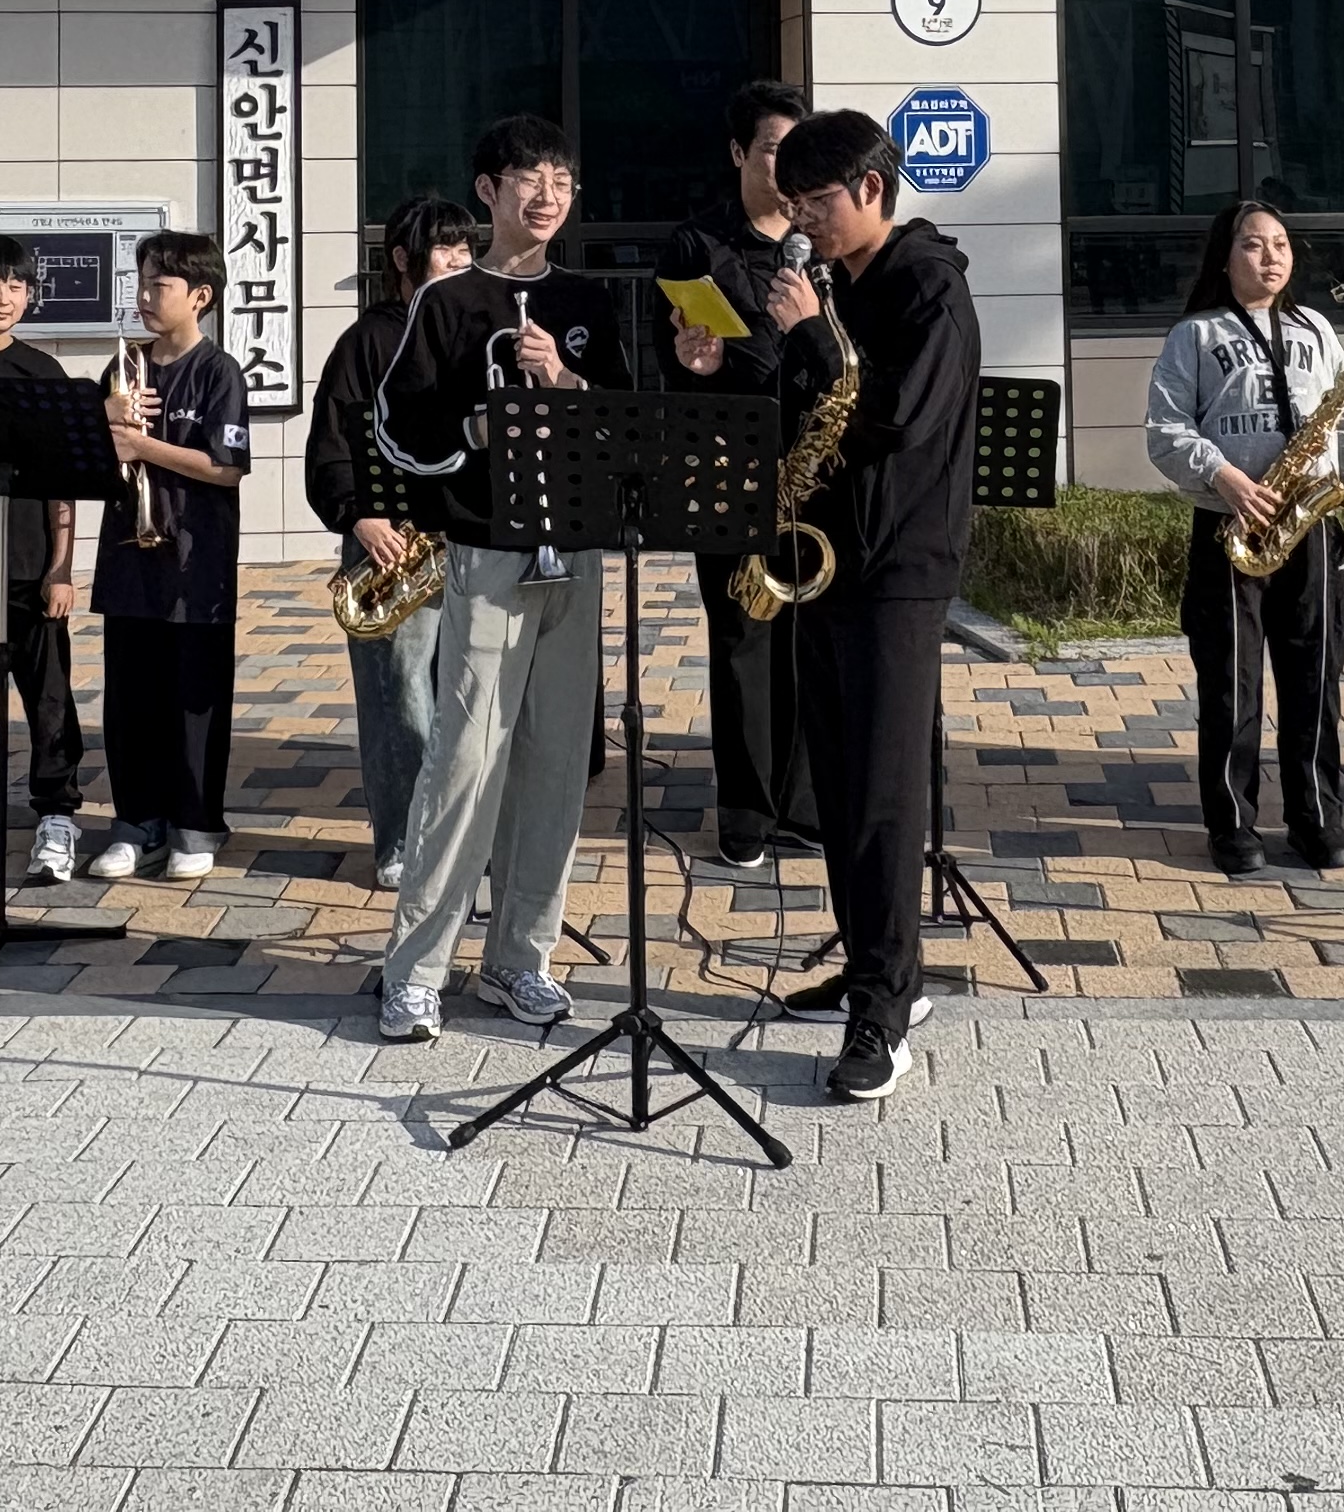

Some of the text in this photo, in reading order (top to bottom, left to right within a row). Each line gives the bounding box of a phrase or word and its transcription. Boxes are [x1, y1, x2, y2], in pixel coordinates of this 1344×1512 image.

[907, 120, 972, 156] ADT
[229, 20, 289, 392] 신안면사무소
[1211, 338, 1314, 377] BRON
